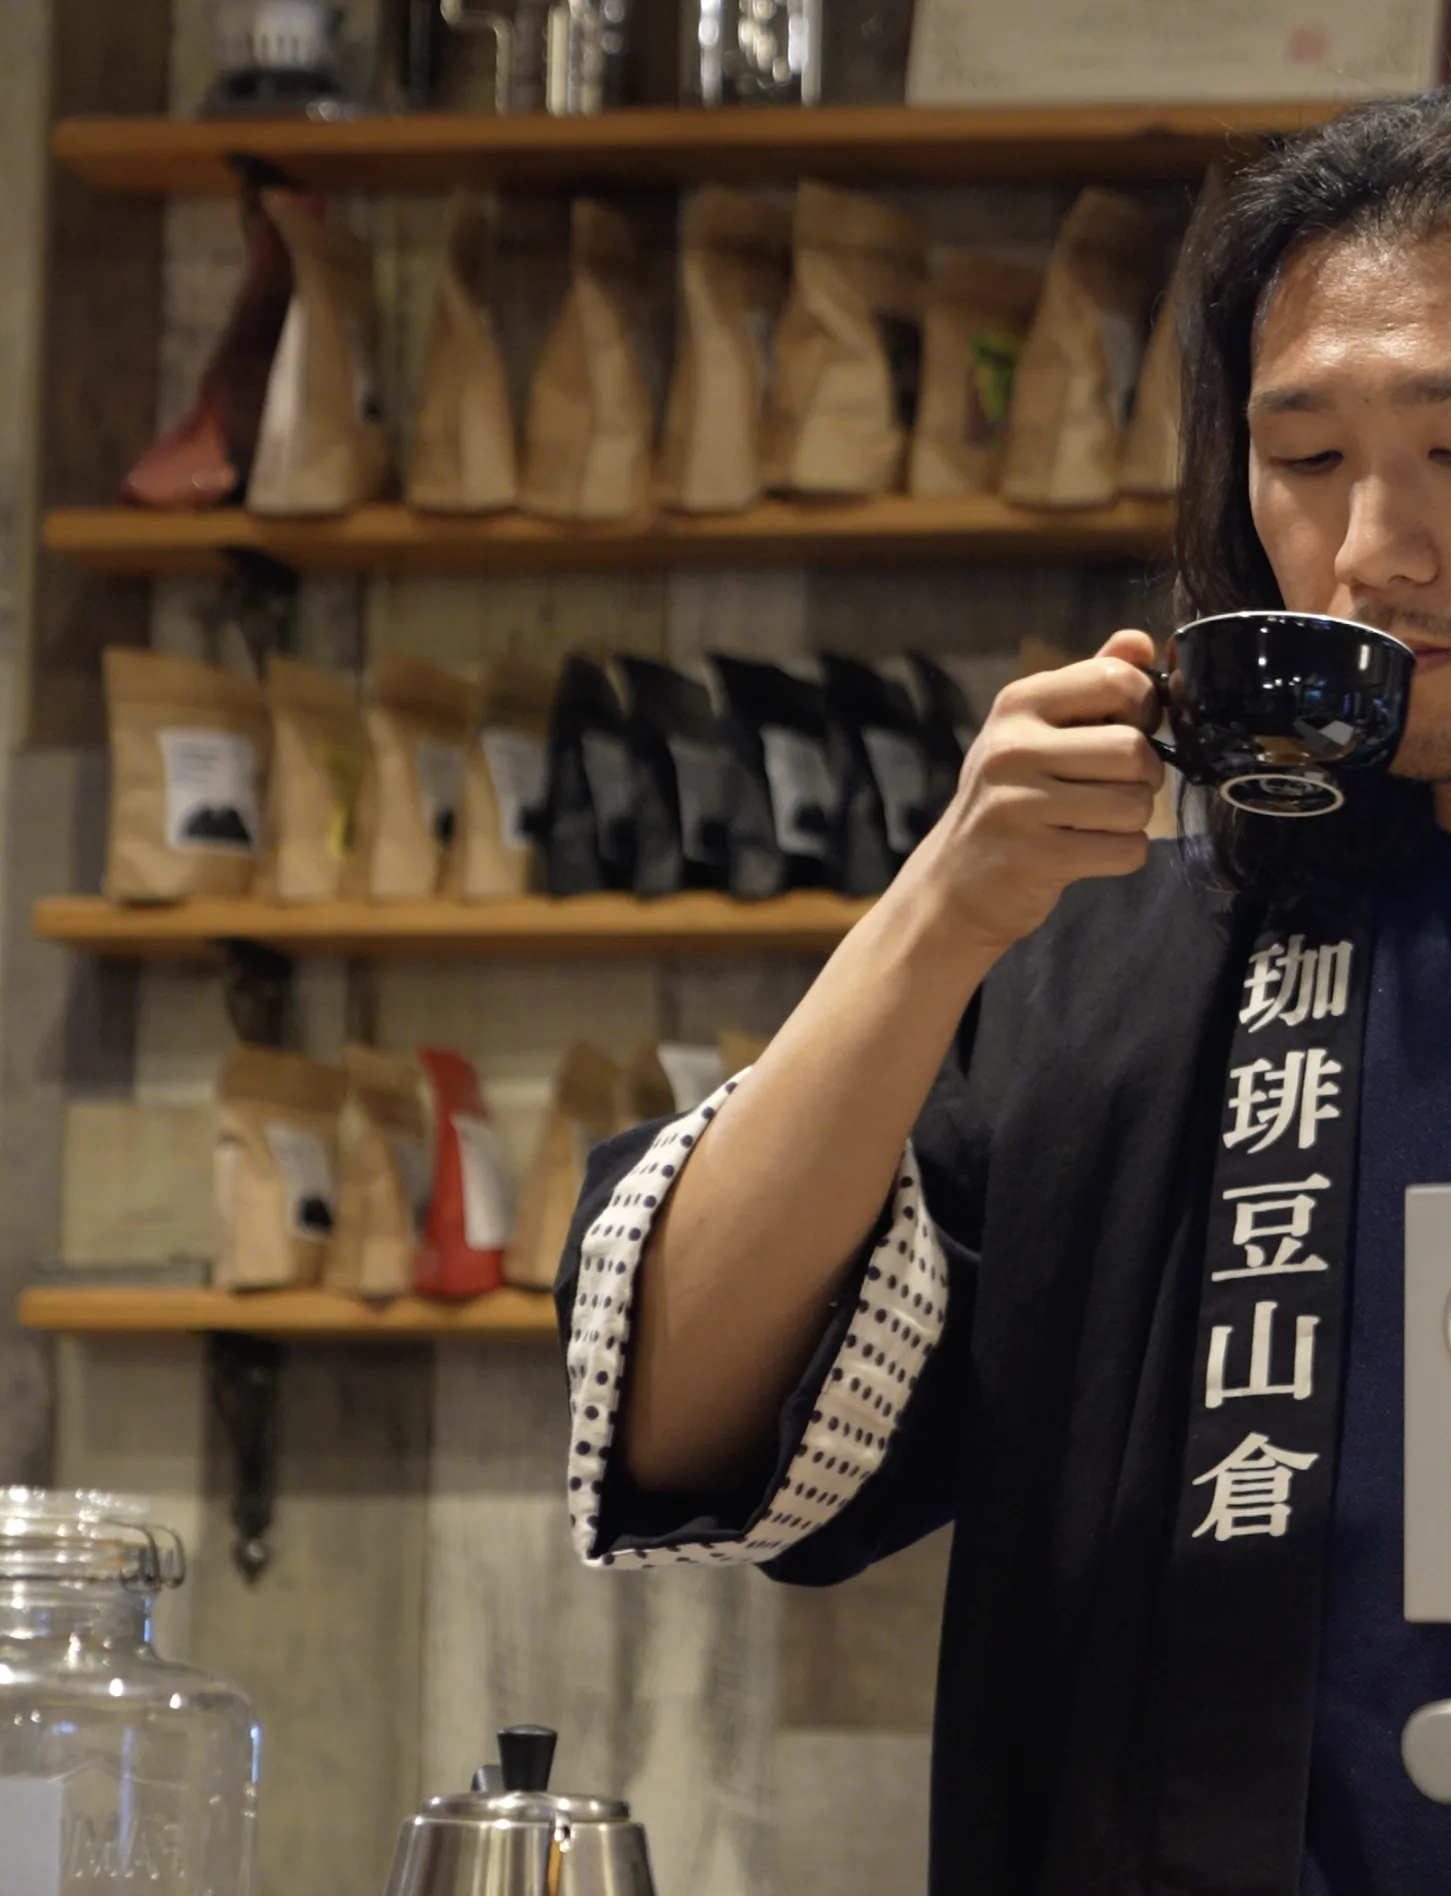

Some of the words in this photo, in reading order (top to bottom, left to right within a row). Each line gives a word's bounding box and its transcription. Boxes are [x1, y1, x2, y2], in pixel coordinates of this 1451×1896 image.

[1192, 935, 1353, 1541] 珈琲豆山倉
